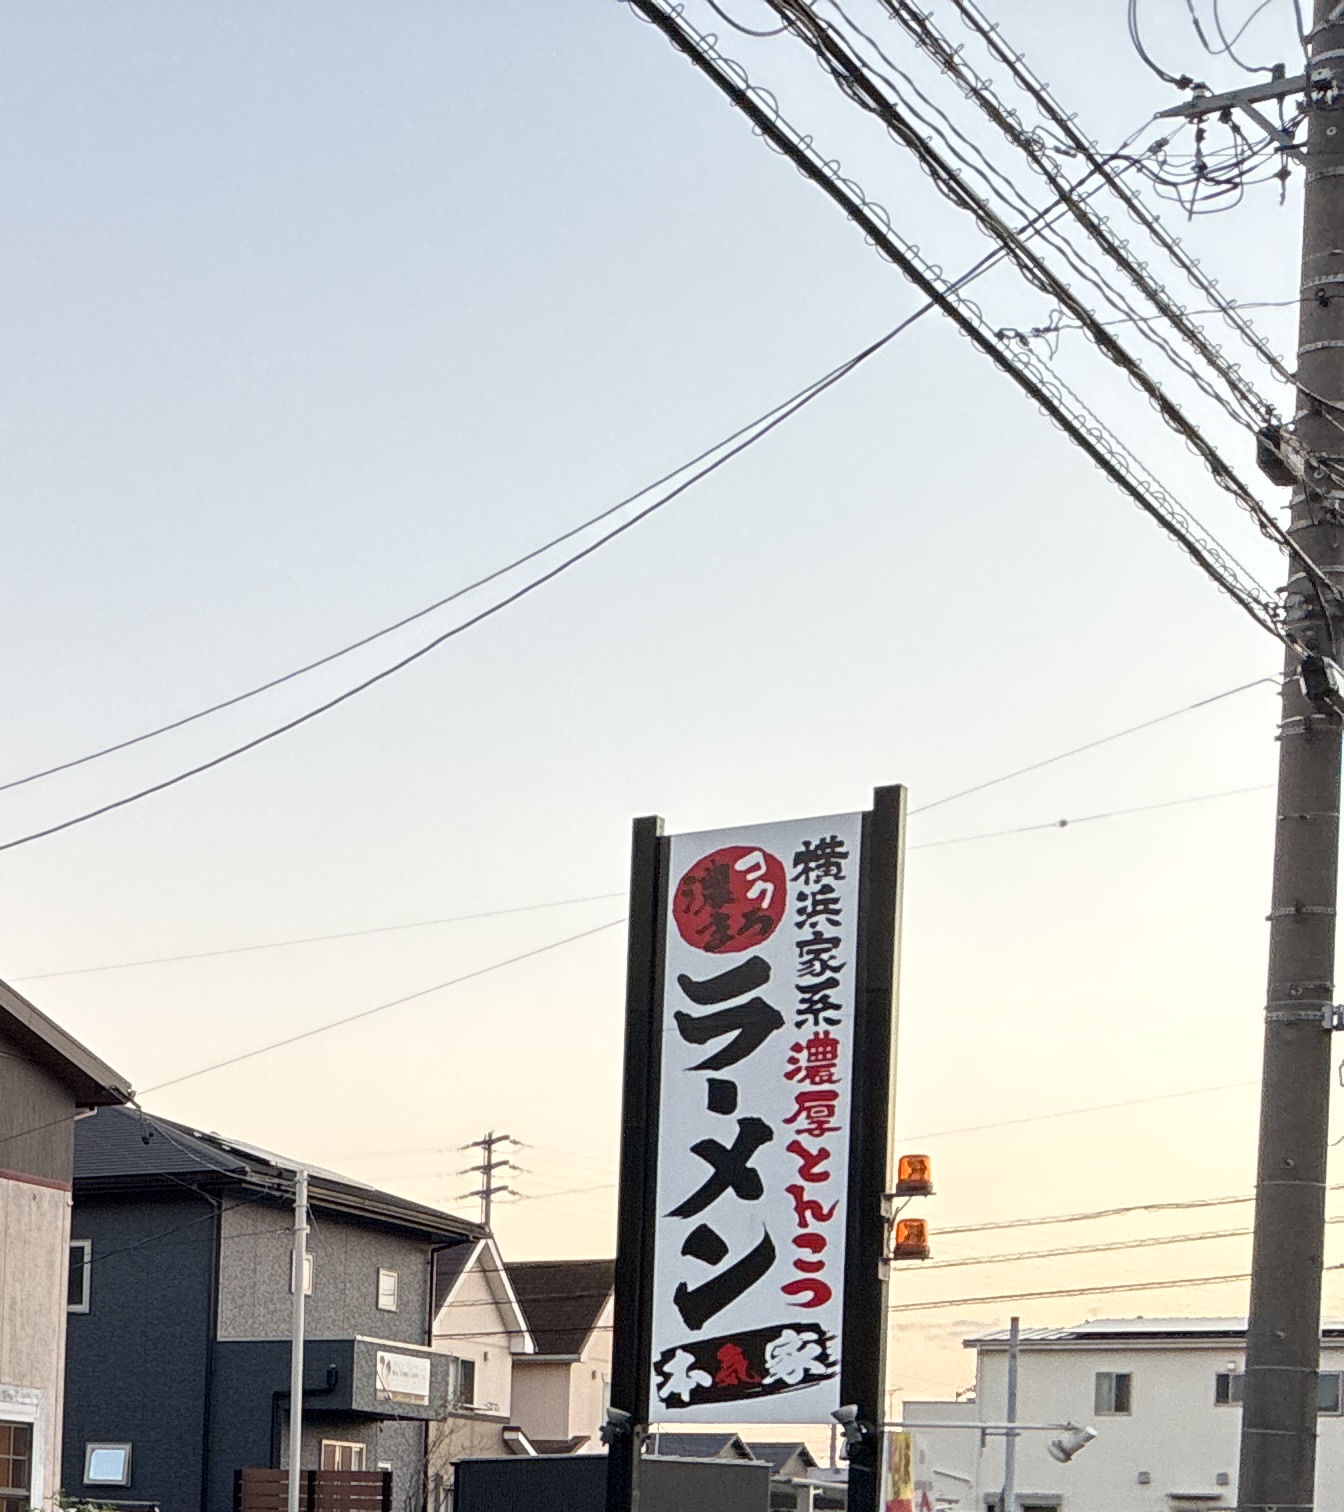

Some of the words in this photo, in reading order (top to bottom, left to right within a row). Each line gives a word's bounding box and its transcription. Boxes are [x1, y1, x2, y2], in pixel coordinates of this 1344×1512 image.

[662, 954, 786, 1331] ラーメン
[781, 834, 850, 1309] 横浜家系濃厚とんこつ
[658, 1328, 830, 1403] 本気家
